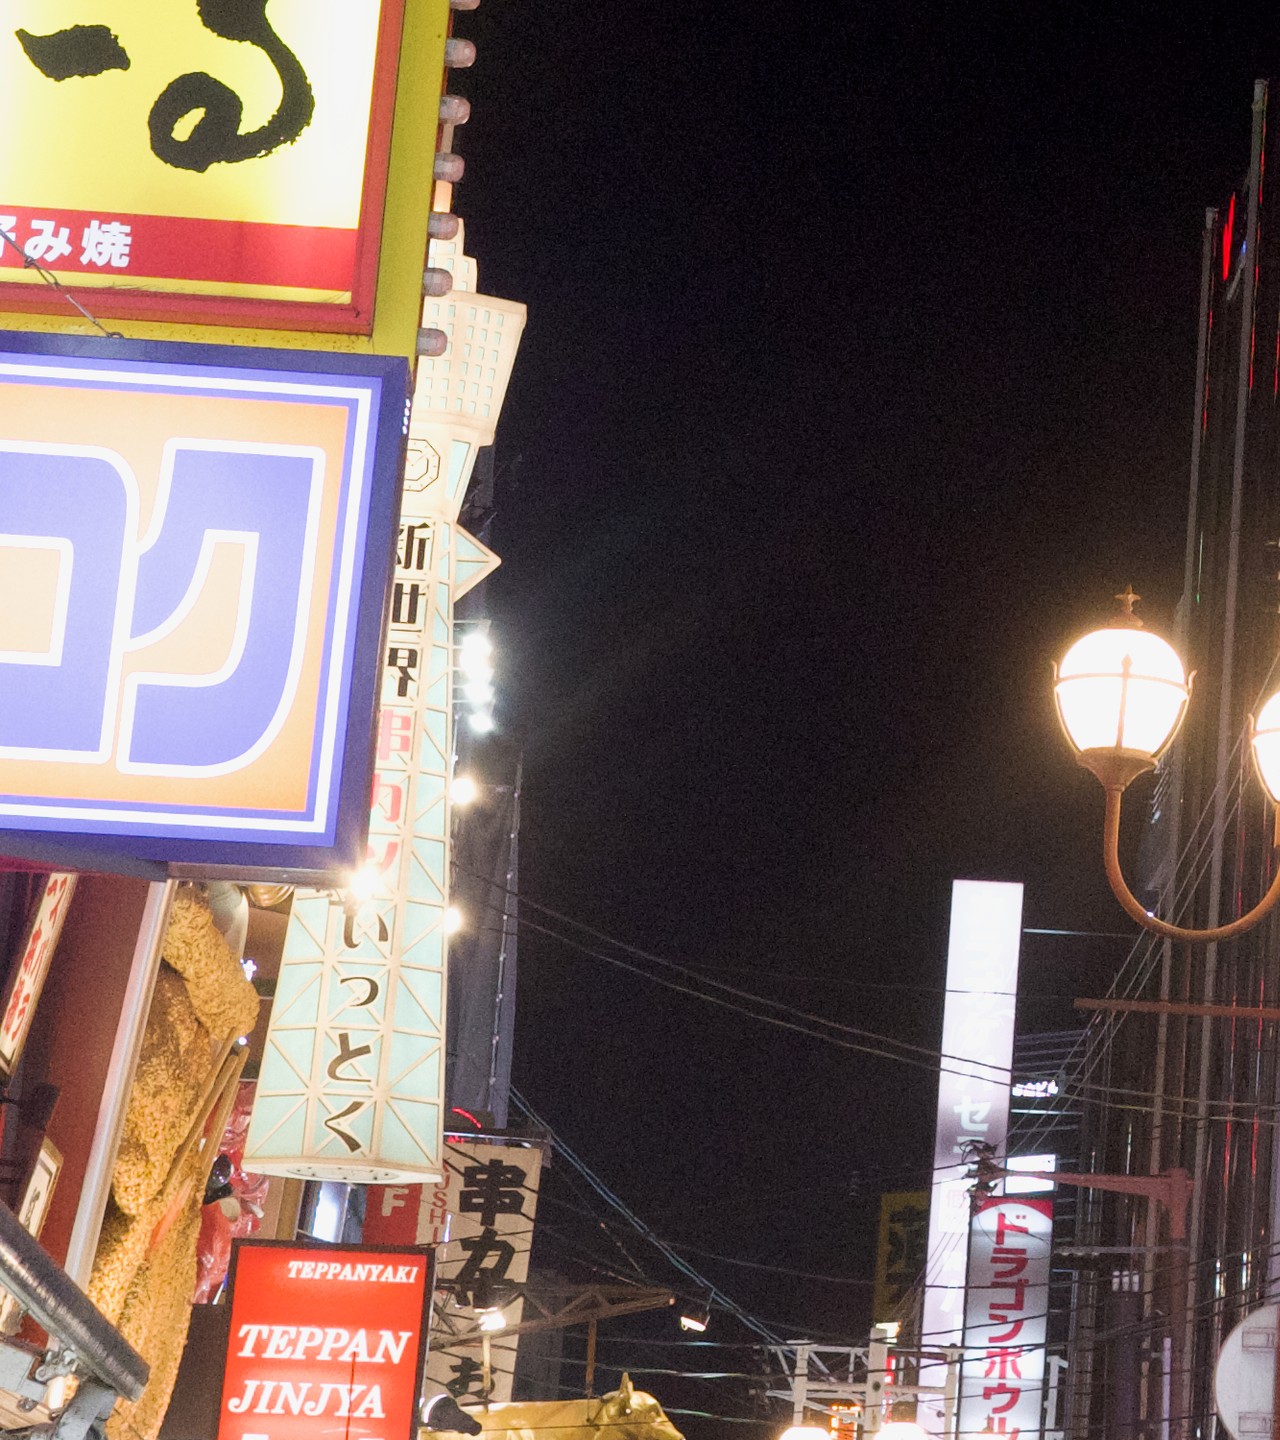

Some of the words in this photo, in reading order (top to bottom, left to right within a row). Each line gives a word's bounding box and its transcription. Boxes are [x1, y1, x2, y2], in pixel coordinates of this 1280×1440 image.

[286, 1258, 420, 1286] TEPPANYAKI
[236, 1321, 413, 1366] TEPPAN
[227, 1377, 387, 1421] JINJYA
